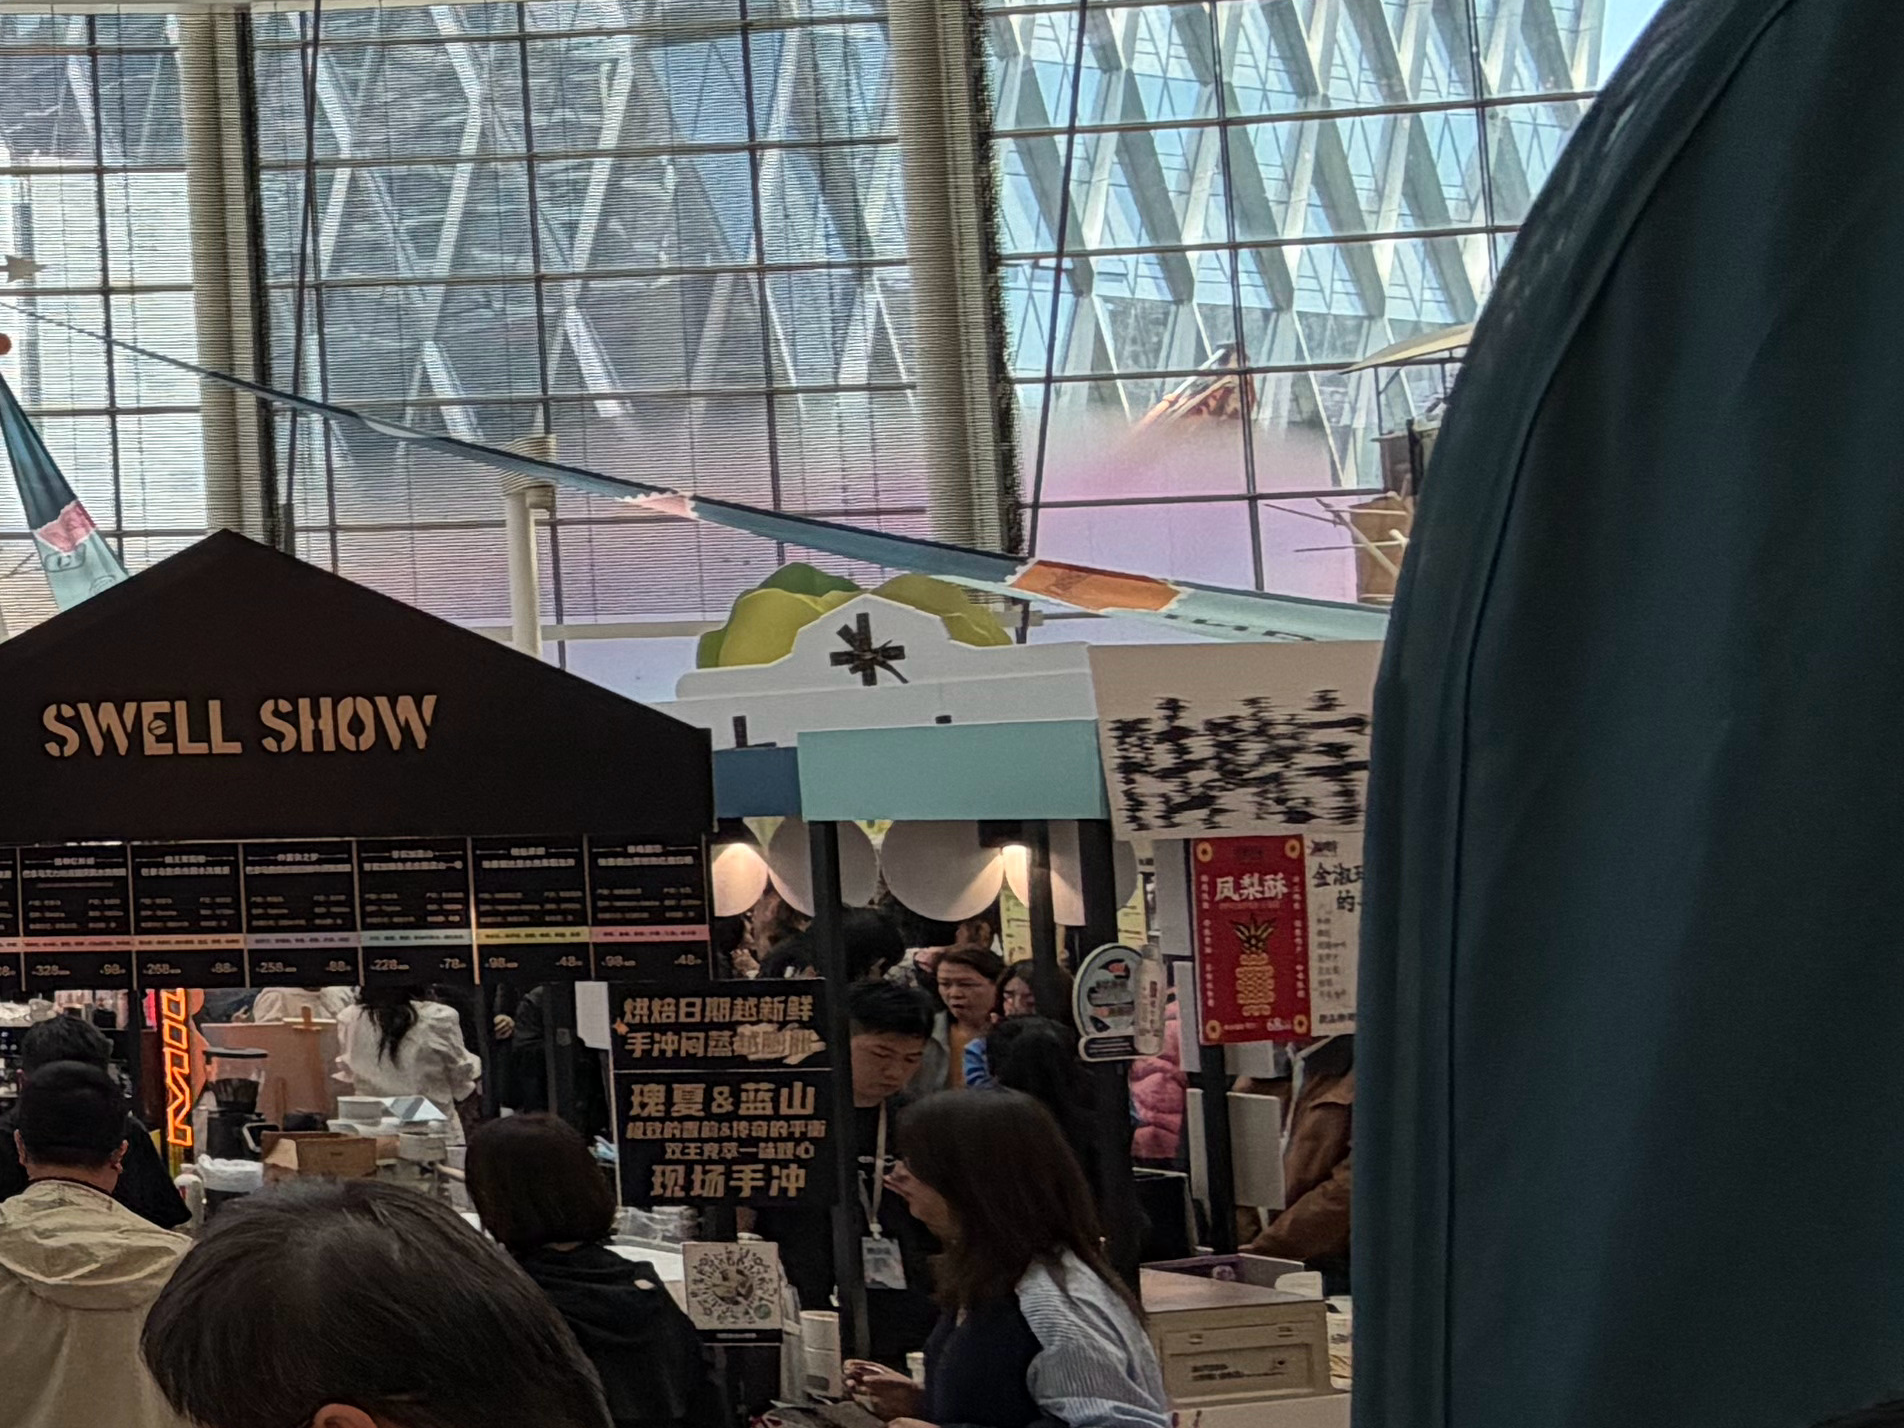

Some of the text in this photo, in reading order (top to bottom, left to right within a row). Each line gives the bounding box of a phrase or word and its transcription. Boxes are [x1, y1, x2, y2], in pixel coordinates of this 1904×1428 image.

[42, 694, 438, 757] SWELL SHOW
[1214, 873, 1289, 901] 凤梨酥
[623, 995, 815, 1024] 烘焙日期越新鲜
[629, 1081, 816, 1118] 瑰夏&蓝山
[650, 1163, 808, 1198] 现场手冲
